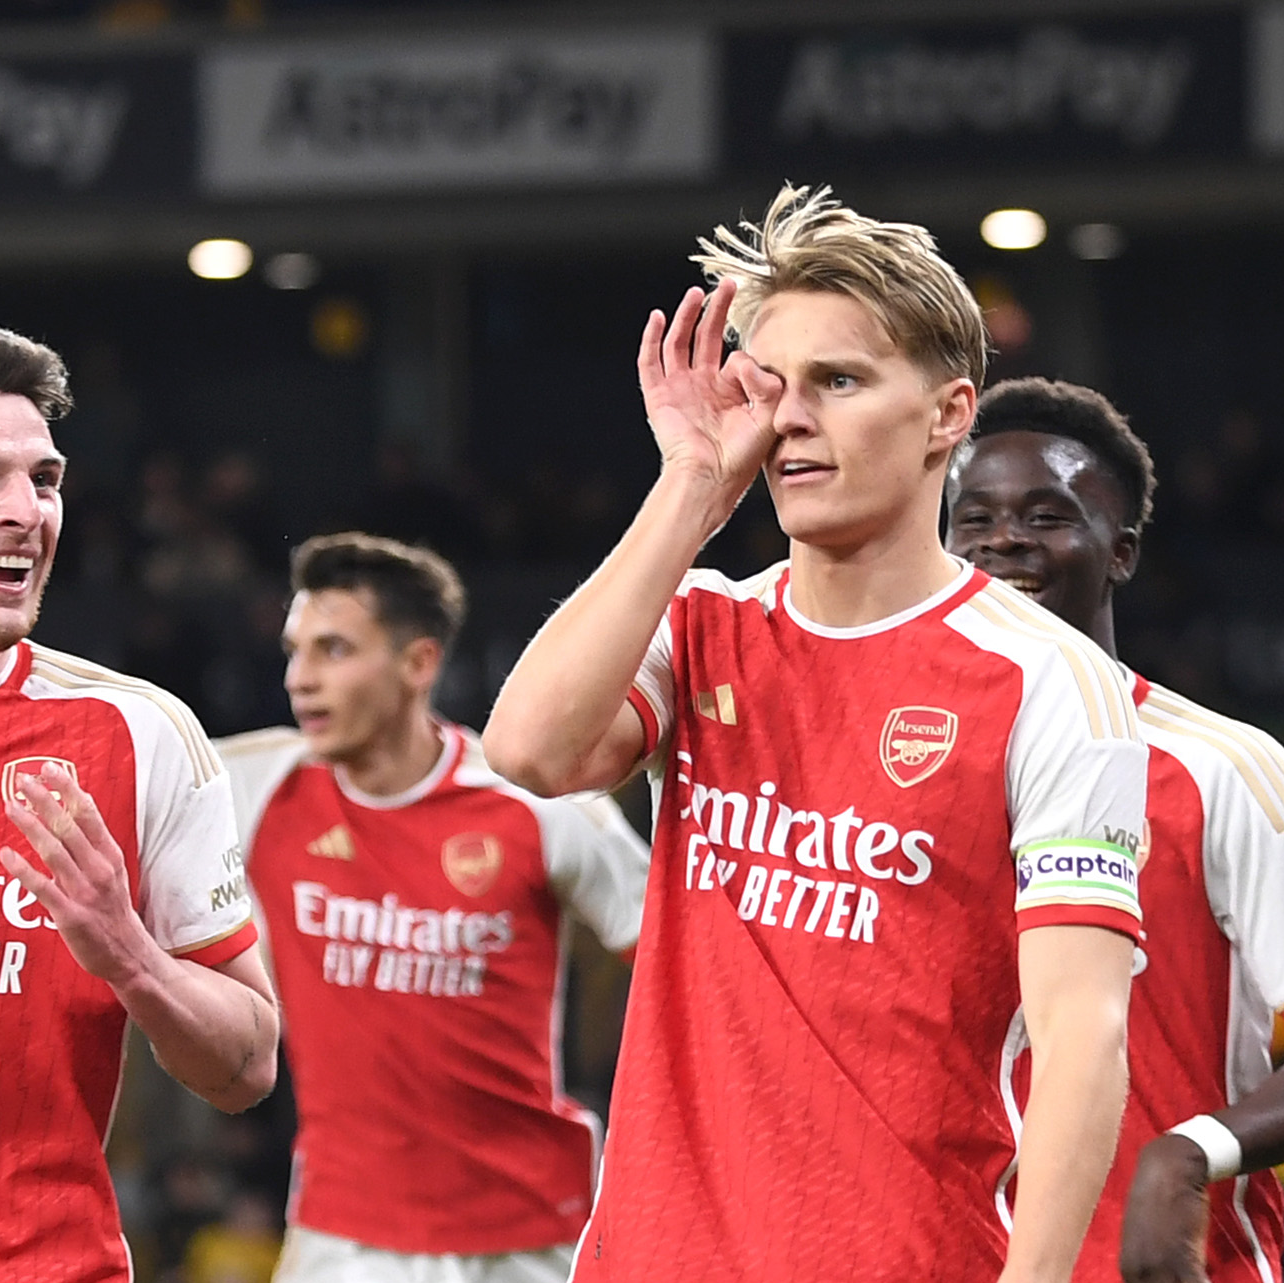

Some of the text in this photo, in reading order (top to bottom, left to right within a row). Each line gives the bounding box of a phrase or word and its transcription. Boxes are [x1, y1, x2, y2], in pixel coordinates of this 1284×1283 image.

[894, 720, 946, 736] Arsenal
[1037, 853, 1137, 887] Captain
[293, 880, 514, 953] Emirates
[737, 864, 879, 944] BETTER
[323, 942, 488, 997] FLY BETTER
